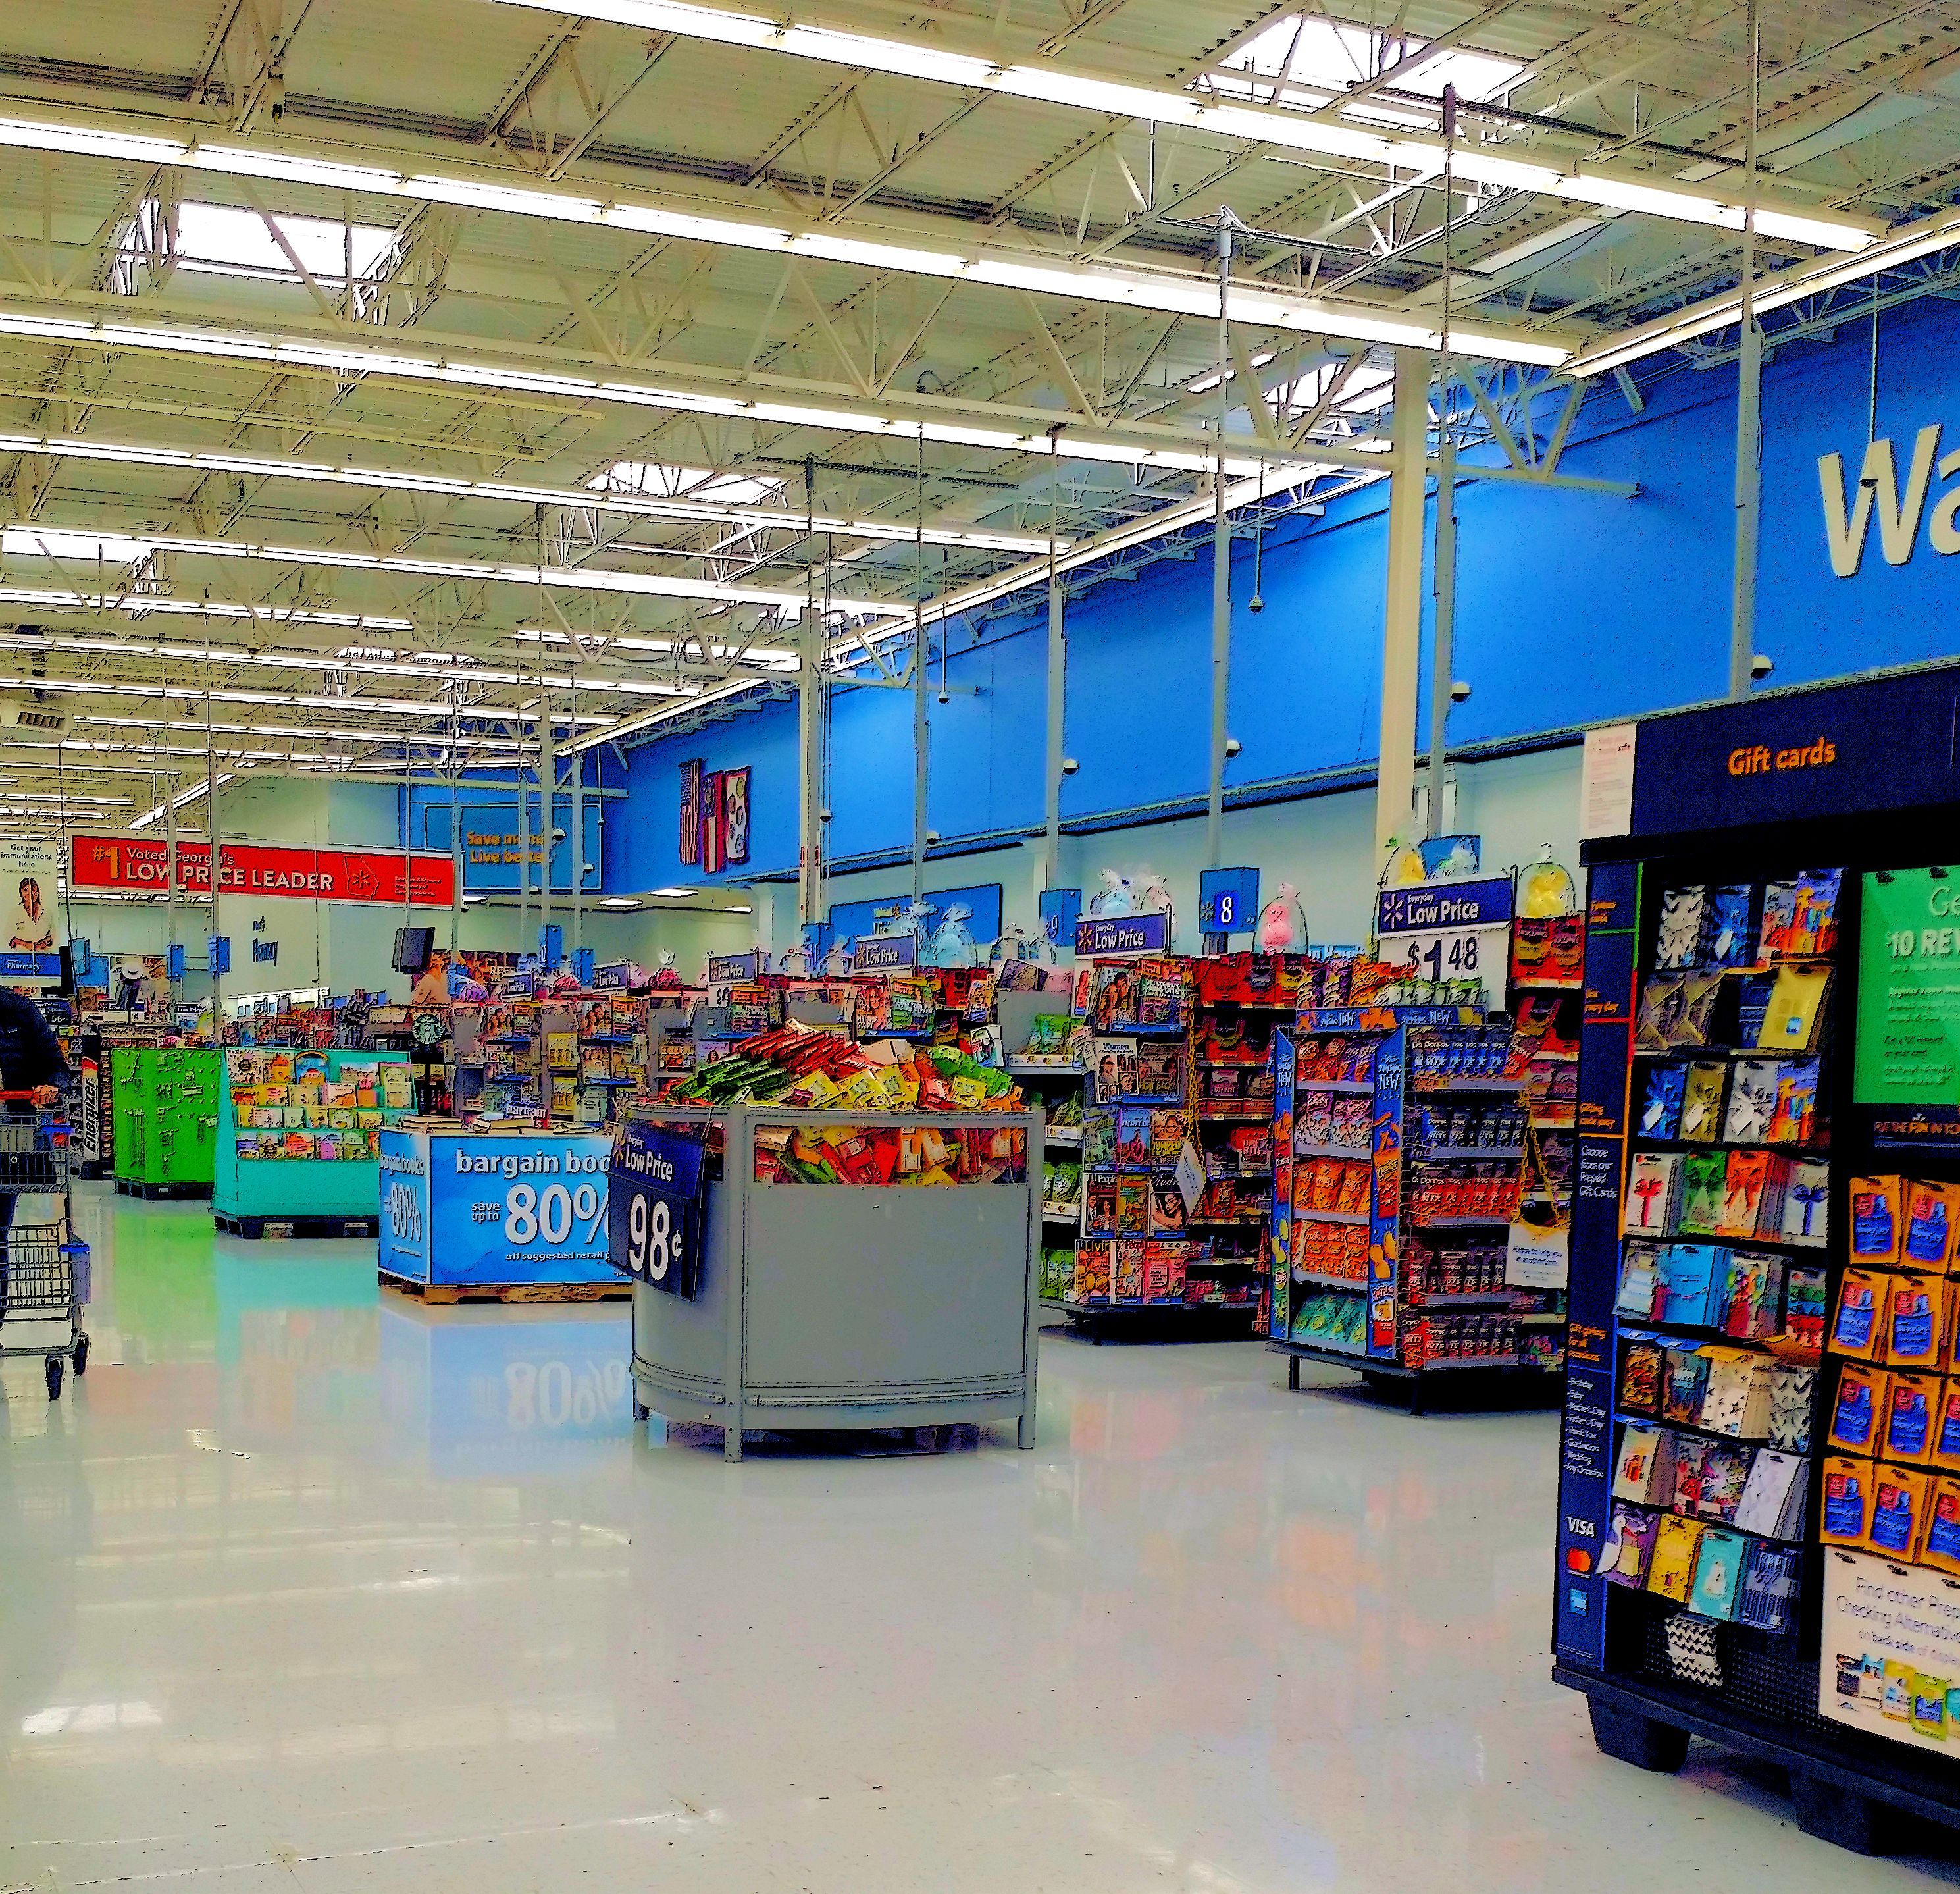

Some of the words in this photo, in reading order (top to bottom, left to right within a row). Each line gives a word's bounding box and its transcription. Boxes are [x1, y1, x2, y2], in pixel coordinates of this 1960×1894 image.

[1728, 745, 1772, 776] Gift
[1776, 735, 1837, 772] cards
[467, 831, 501, 845] Save
[93, 845, 119, 879] #1
[126, 845, 166, 861] Voted
[470, 849, 500, 864] Live
[182, 866, 246, 885] PRCE
[252, 867, 334, 891] LEADER
[1221, 896, 1233, 923] 8
[1408, 903, 1439, 926] Low
[1441, 897, 1479, 922] Price
[1095, 931, 1116, 950] Low
[1118, 928, 1145, 947] Price
[1921, 926, 1960, 959] RE
[867, 950, 881, 966] Low
[882, 948, 900, 964] Price
[84, 1078, 97, 1153] Energizer
[456, 1147, 559, 1179] bargain
[566, 1148, 610, 1174] boo
[625, 1145, 645, 1173] Low
[646, 1150, 673, 1182] Price
[1150, 1173, 1180, 1186] Audr
[471, 1200, 501, 1212] save
[472, 1212, 486, 1224] up
[488, 1212, 500, 1222] to
[504, 1182, 609, 1245] 80%
[505, 1252, 520, 1261] off
[522, 1253, 575, 1263] suggested
[576, 1251, 604, 1260] retail
[1566, 1515, 1595, 1538] VISA
[1856, 1576, 1884, 1600] Find
[1928, 1594, 1960, 1623] Prep
